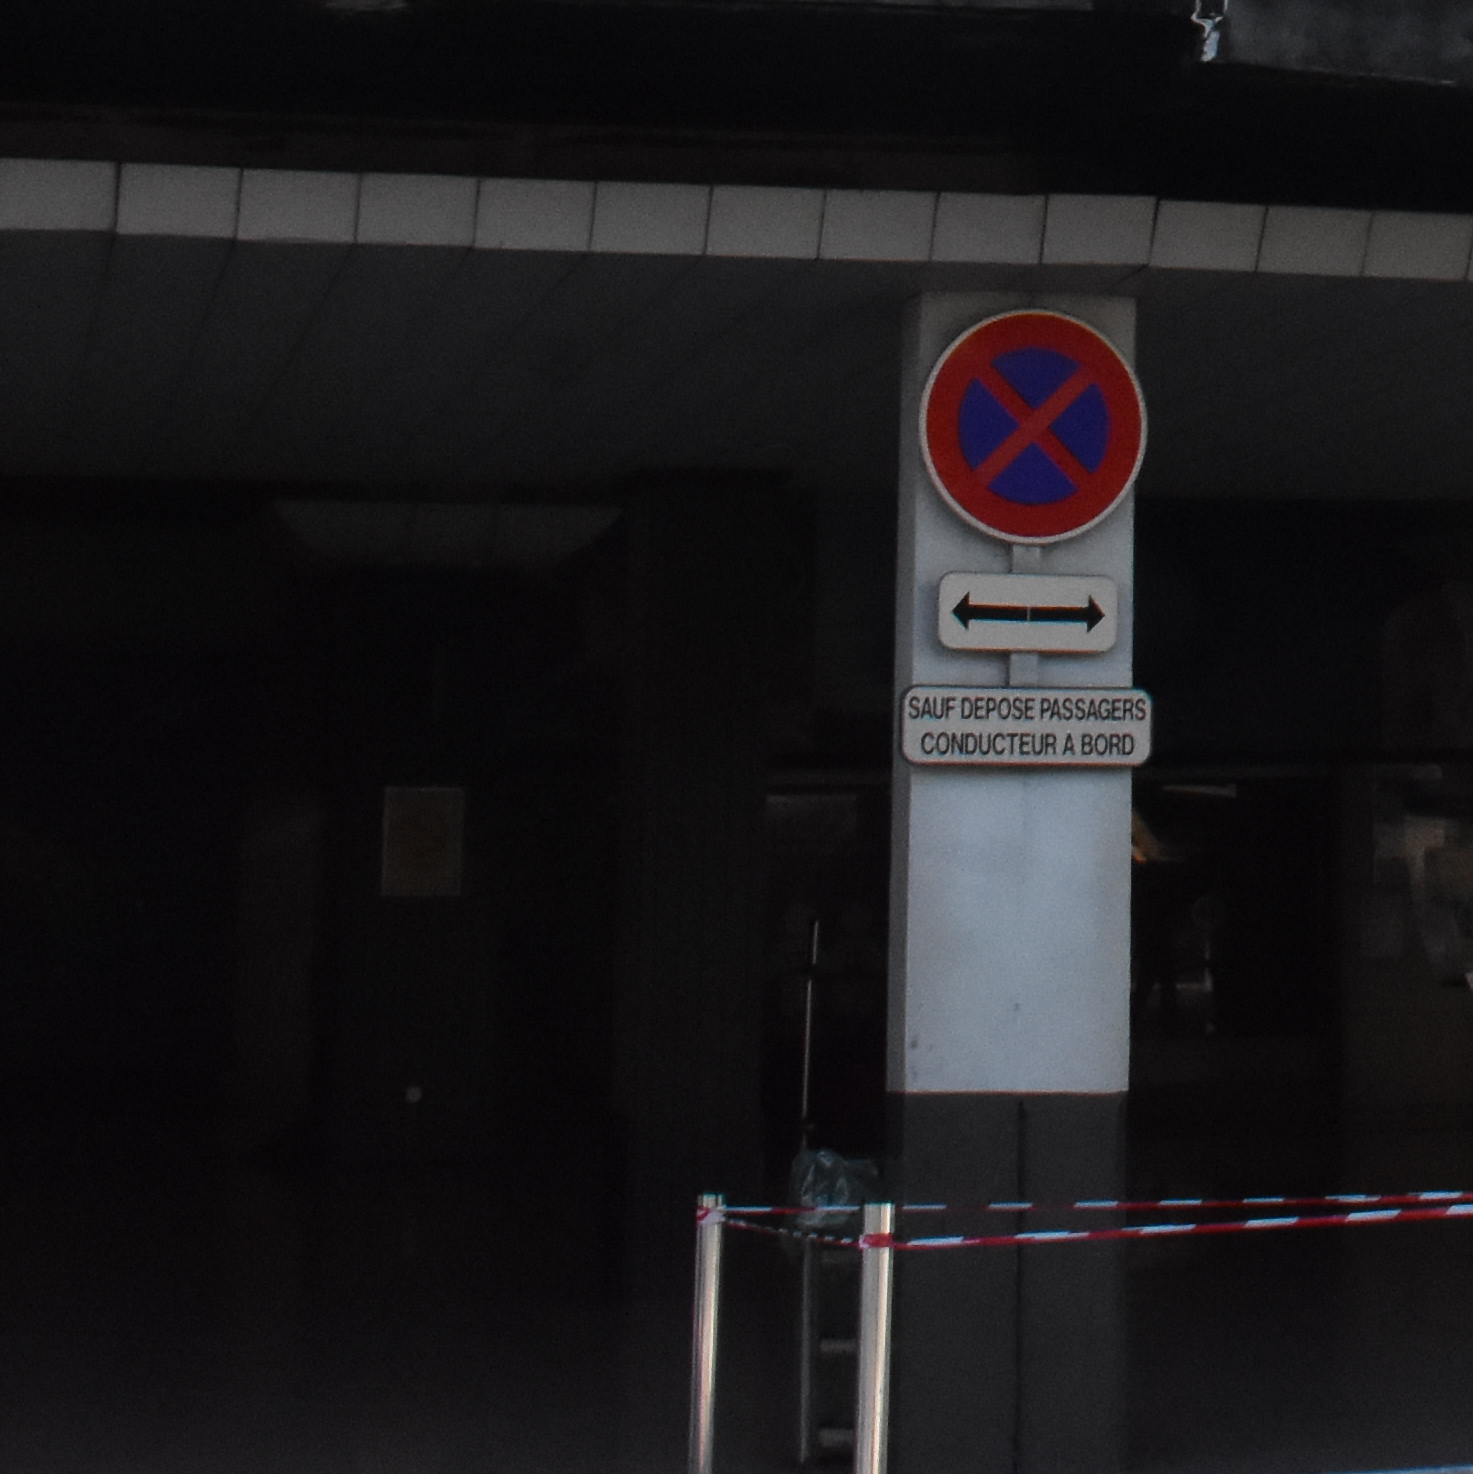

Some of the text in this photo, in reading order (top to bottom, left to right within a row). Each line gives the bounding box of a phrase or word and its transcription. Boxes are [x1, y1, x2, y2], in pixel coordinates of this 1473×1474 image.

[908, 695, 1147, 722] SAUF DEPOSE PASSAGERS
[920, 731, 1135, 757] CONDUCTEUR A BORD
